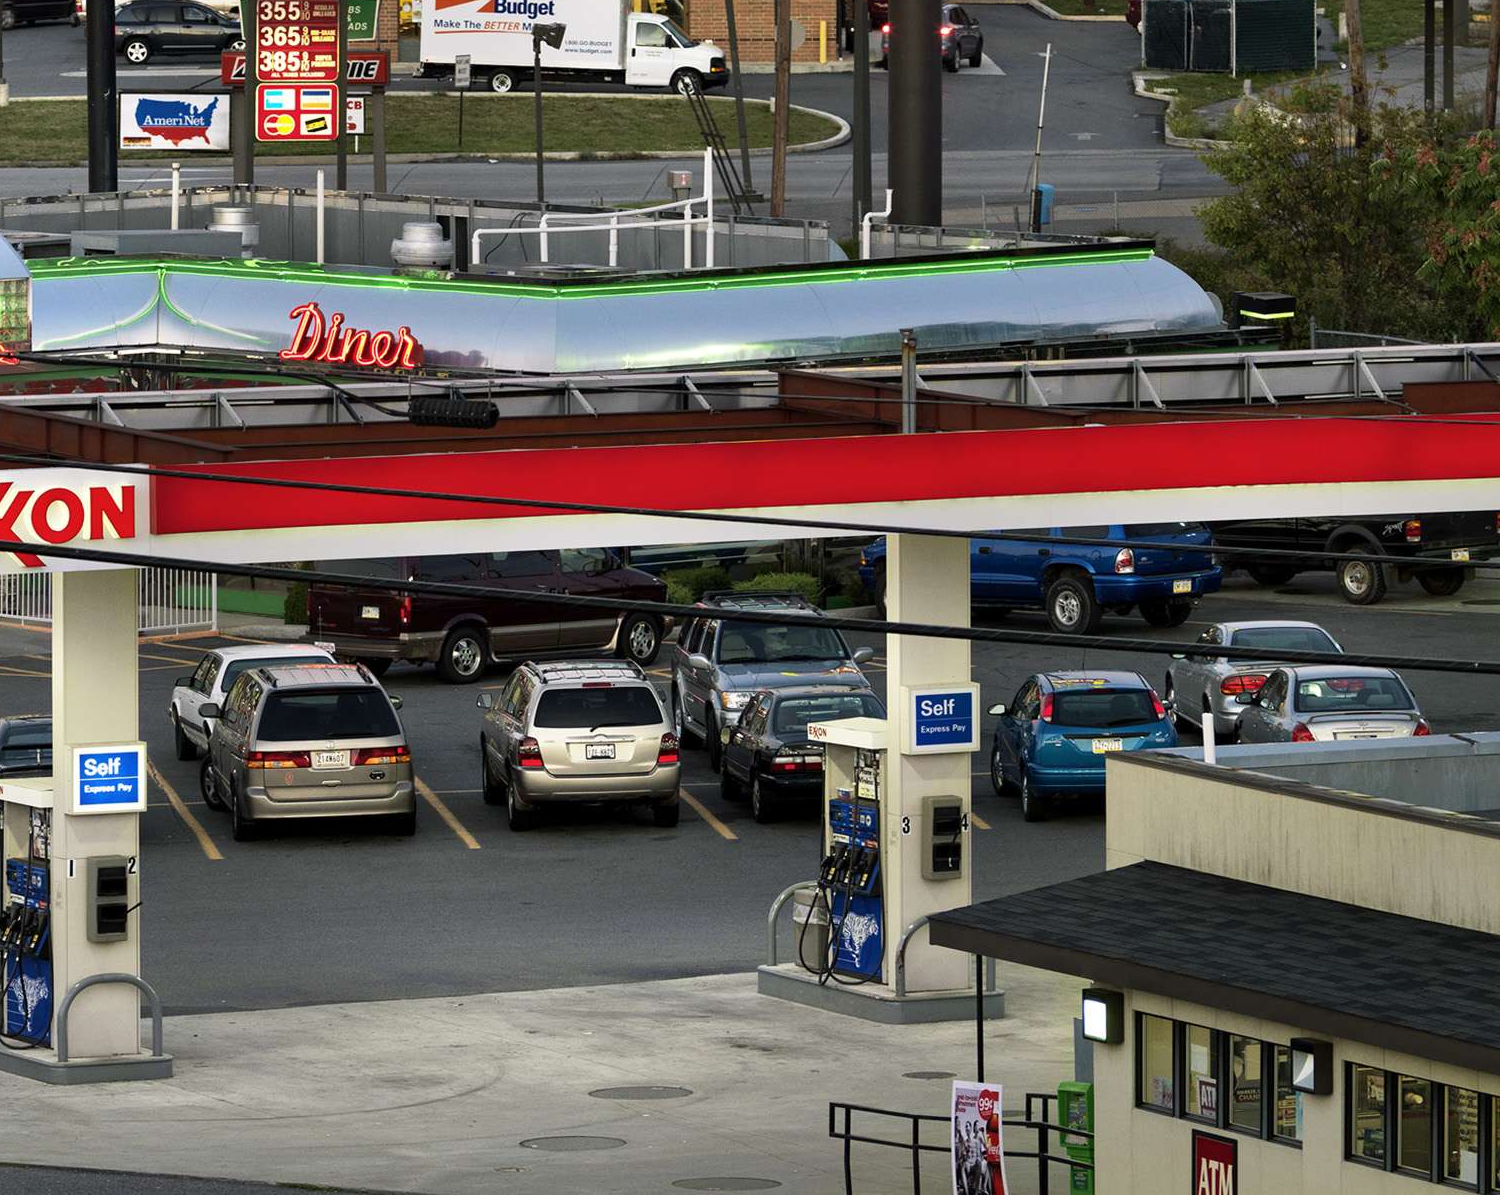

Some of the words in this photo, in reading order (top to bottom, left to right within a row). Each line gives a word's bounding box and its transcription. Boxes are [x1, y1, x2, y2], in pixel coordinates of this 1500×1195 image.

[260, 1, 301, 21] 355
[434, 19, 461, 29] Make
[463, 19, 482, 29] The
[483, 21, 520, 32] BETTER
[260, 26, 301, 47] 365
[259, 51, 301, 72] 385
[143, 113, 205, 127] AmeriNet
[278, 299, 426, 371] Diner
[920, 698, 955, 717] Self
[808, 725, 828, 740] EXXON
[920, 723, 950, 734] Express
[952, 723, 967, 733] Pay
[83, 757, 122, 777] Self
[83, 783, 114, 795] Express
[116, 782, 133, 793] Pay
[902, 816, 911, 835] 3
[961, 813, 969, 832] 4
[69, 859, 75, 878] 1
[128, 857, 137, 875] 2
[1198, 1157, 1234, 1195] ATM
